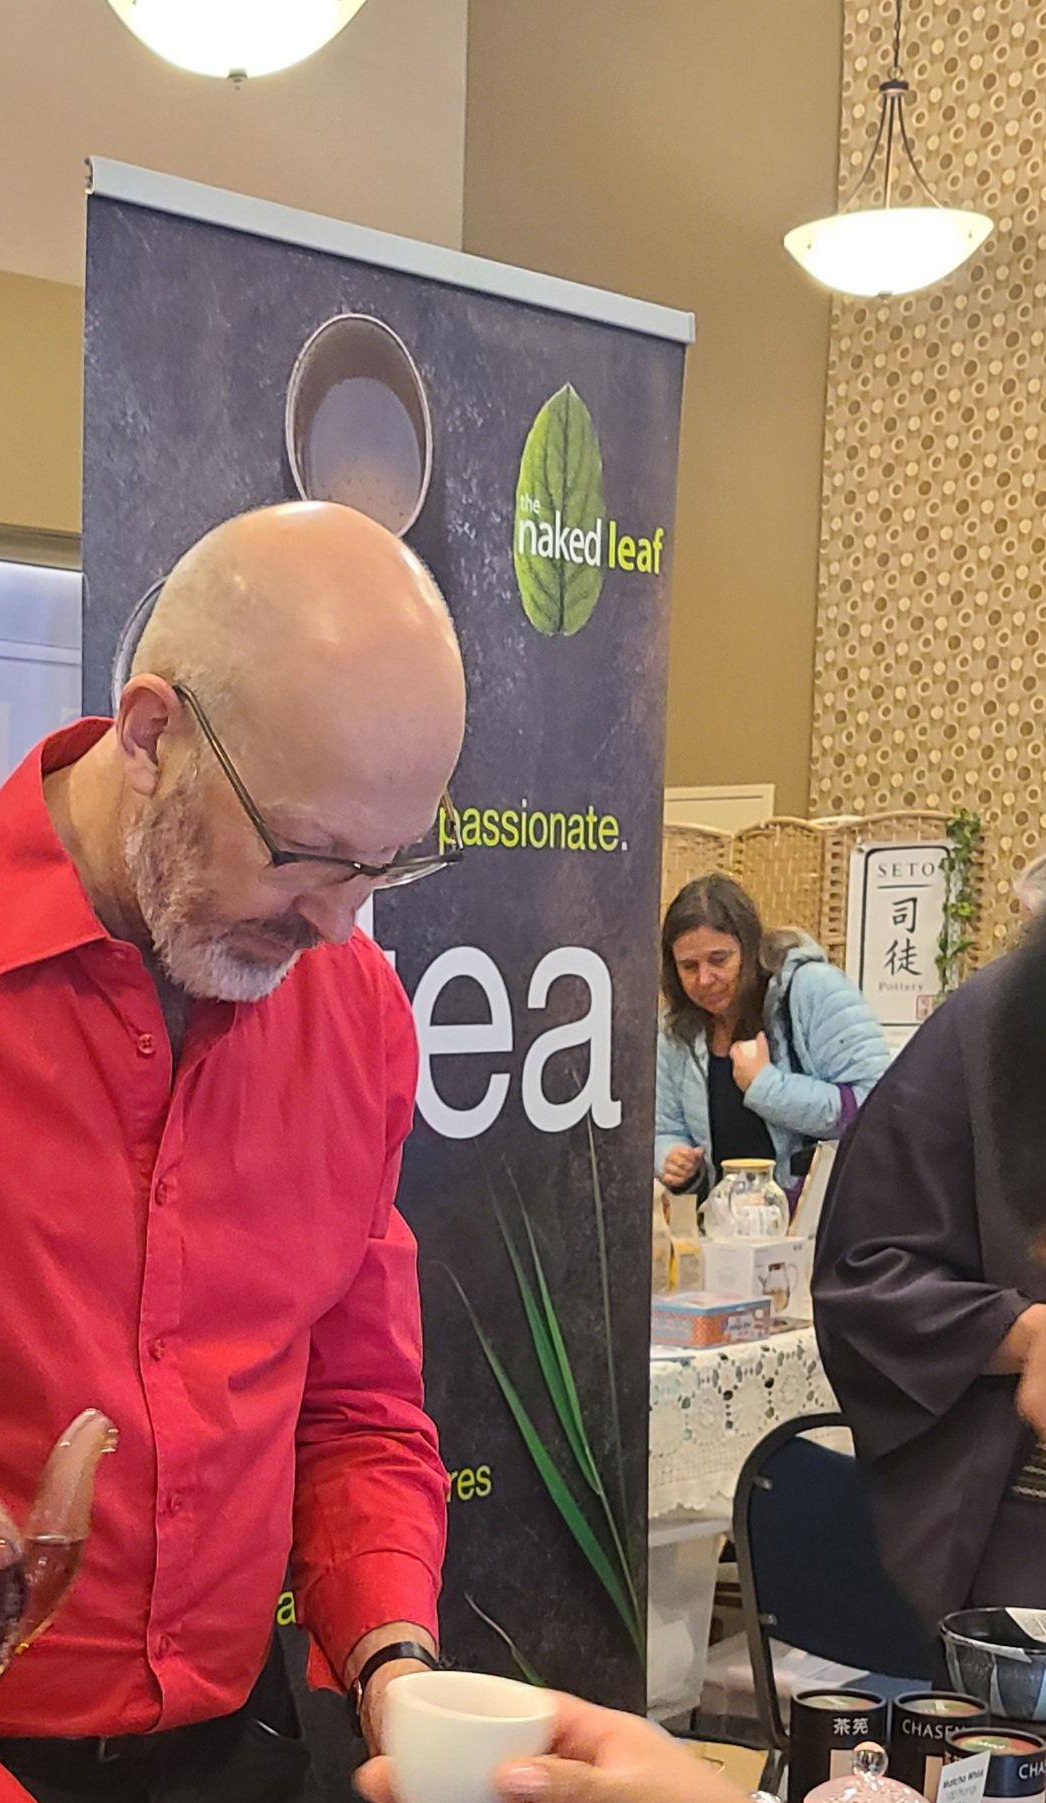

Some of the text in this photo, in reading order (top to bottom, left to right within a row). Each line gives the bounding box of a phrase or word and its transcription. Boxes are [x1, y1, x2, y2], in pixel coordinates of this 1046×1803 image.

[520, 492, 540, 514] the
[518, 509, 664, 575] naked leaf
[439, 799, 627, 855] passionate.
[877, 862, 935, 878] SETO
[884, 897, 922, 976] 司徒
[879, 981, 924, 992] Pottery
[356, 890, 622, 1139] ea
[447, 1464, 492, 1502] res
